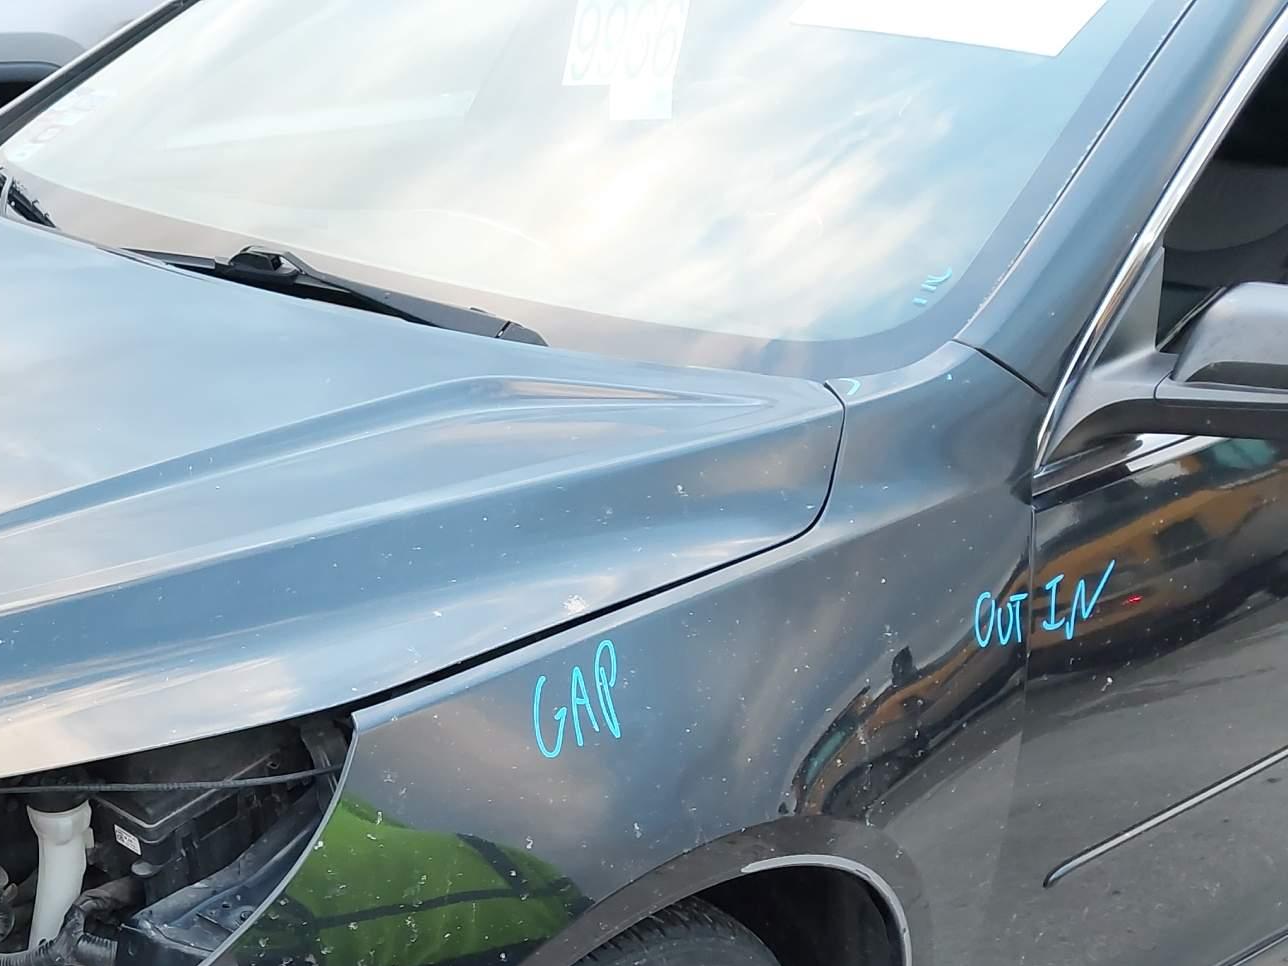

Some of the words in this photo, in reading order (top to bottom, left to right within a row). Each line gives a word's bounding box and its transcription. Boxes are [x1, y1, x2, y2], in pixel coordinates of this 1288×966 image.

[972, 591, 1029, 648] OUT
[1041, 559, 1116, 641] IN
[532, 638, 622, 759] GAP
